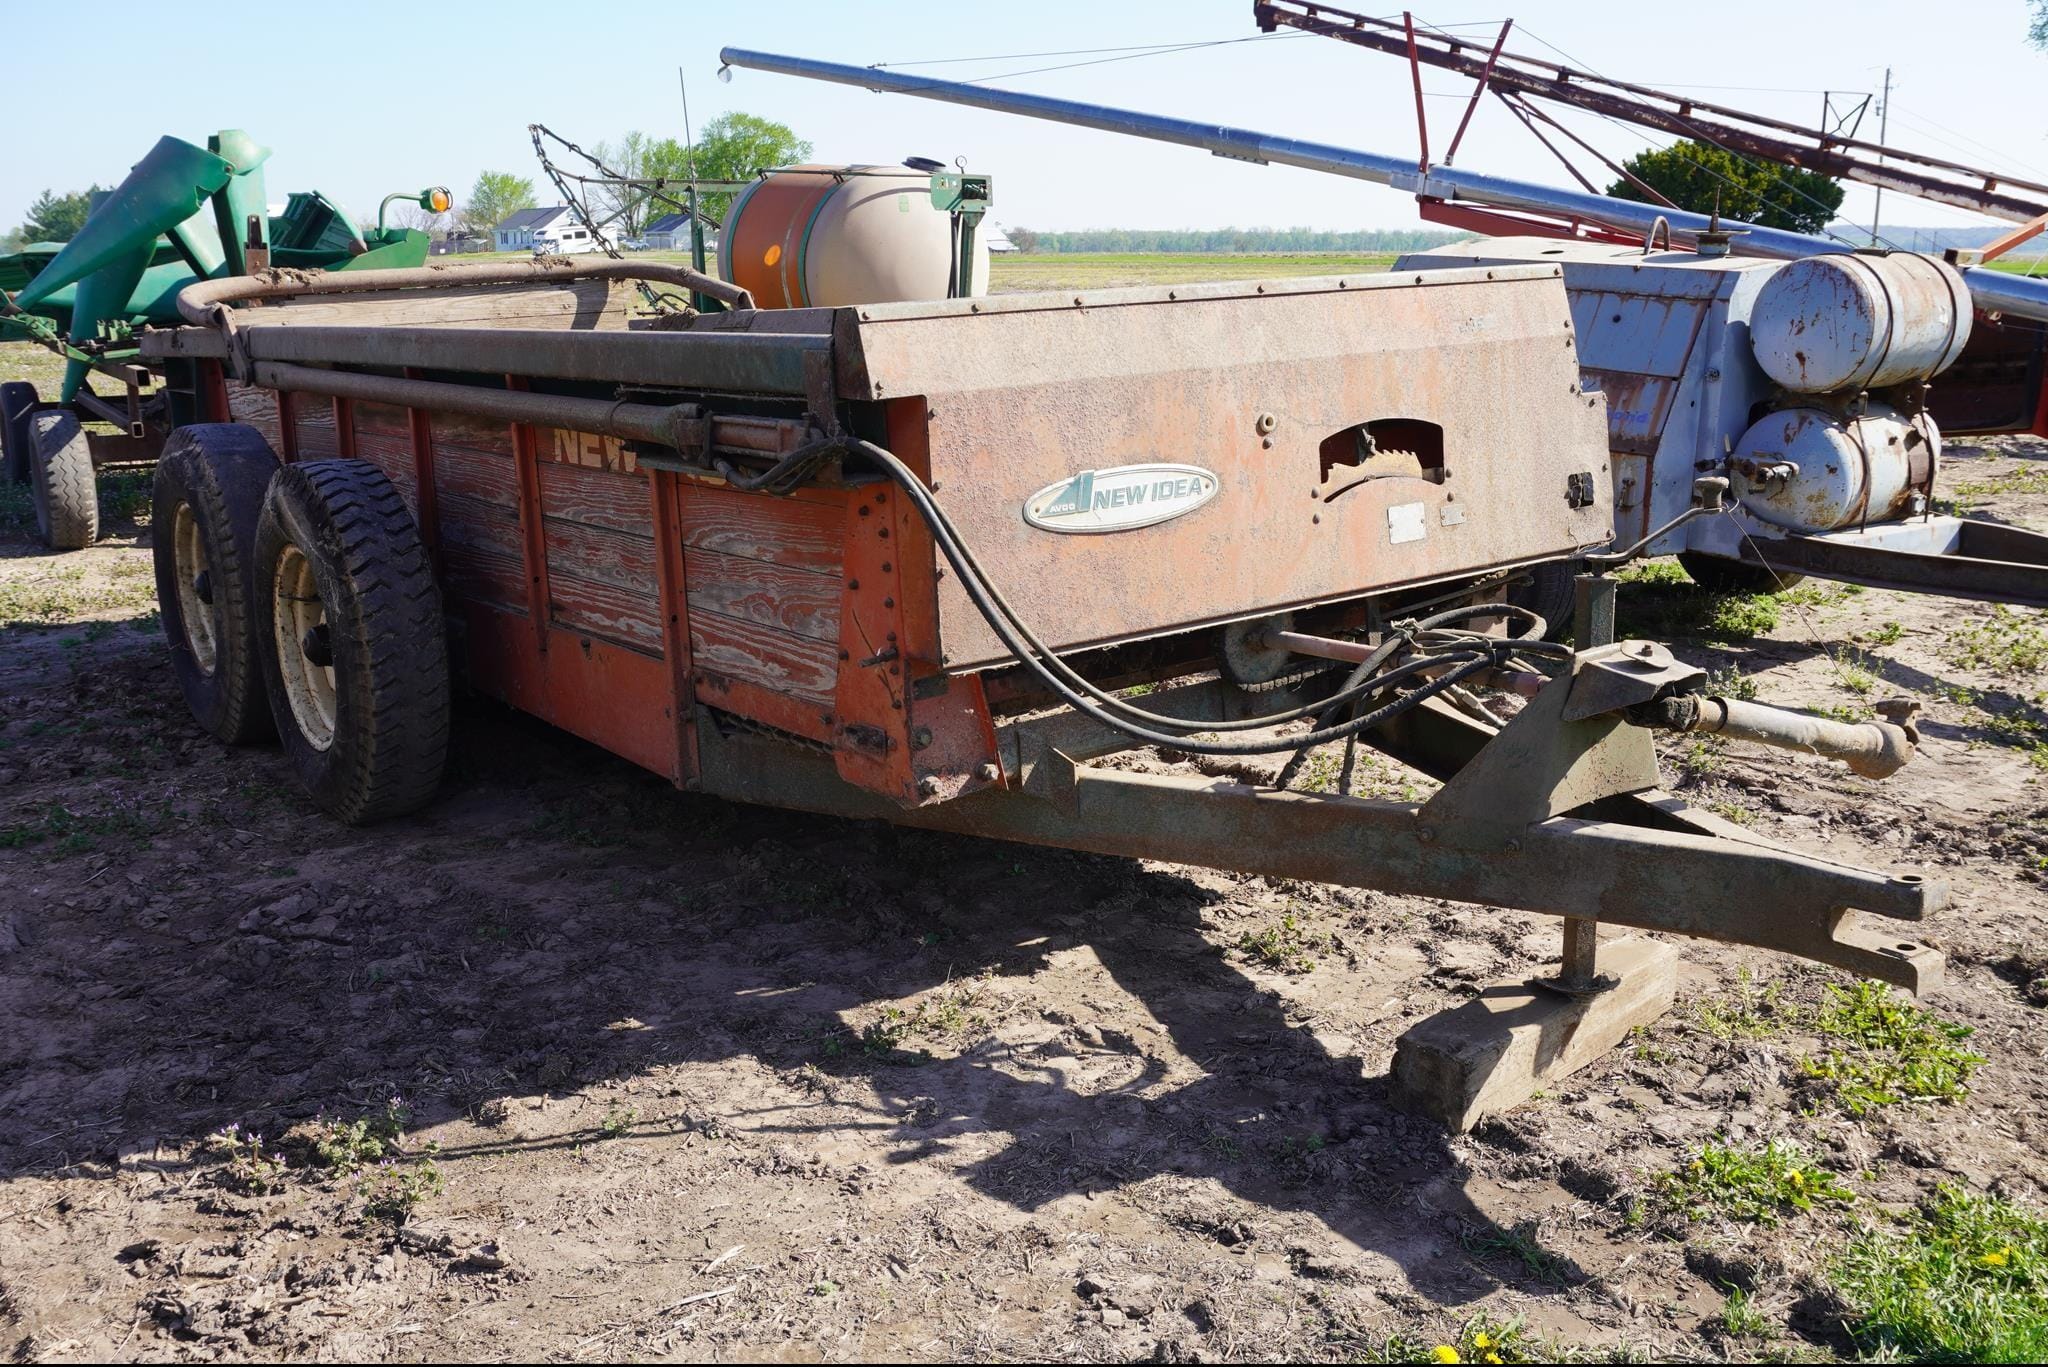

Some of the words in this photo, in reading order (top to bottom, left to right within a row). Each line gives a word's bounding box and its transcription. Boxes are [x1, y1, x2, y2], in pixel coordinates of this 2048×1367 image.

[554, 428, 636, 473] NEW
[1093, 484, 1148, 511] NEW
[1152, 477, 1202, 502] IDEA
